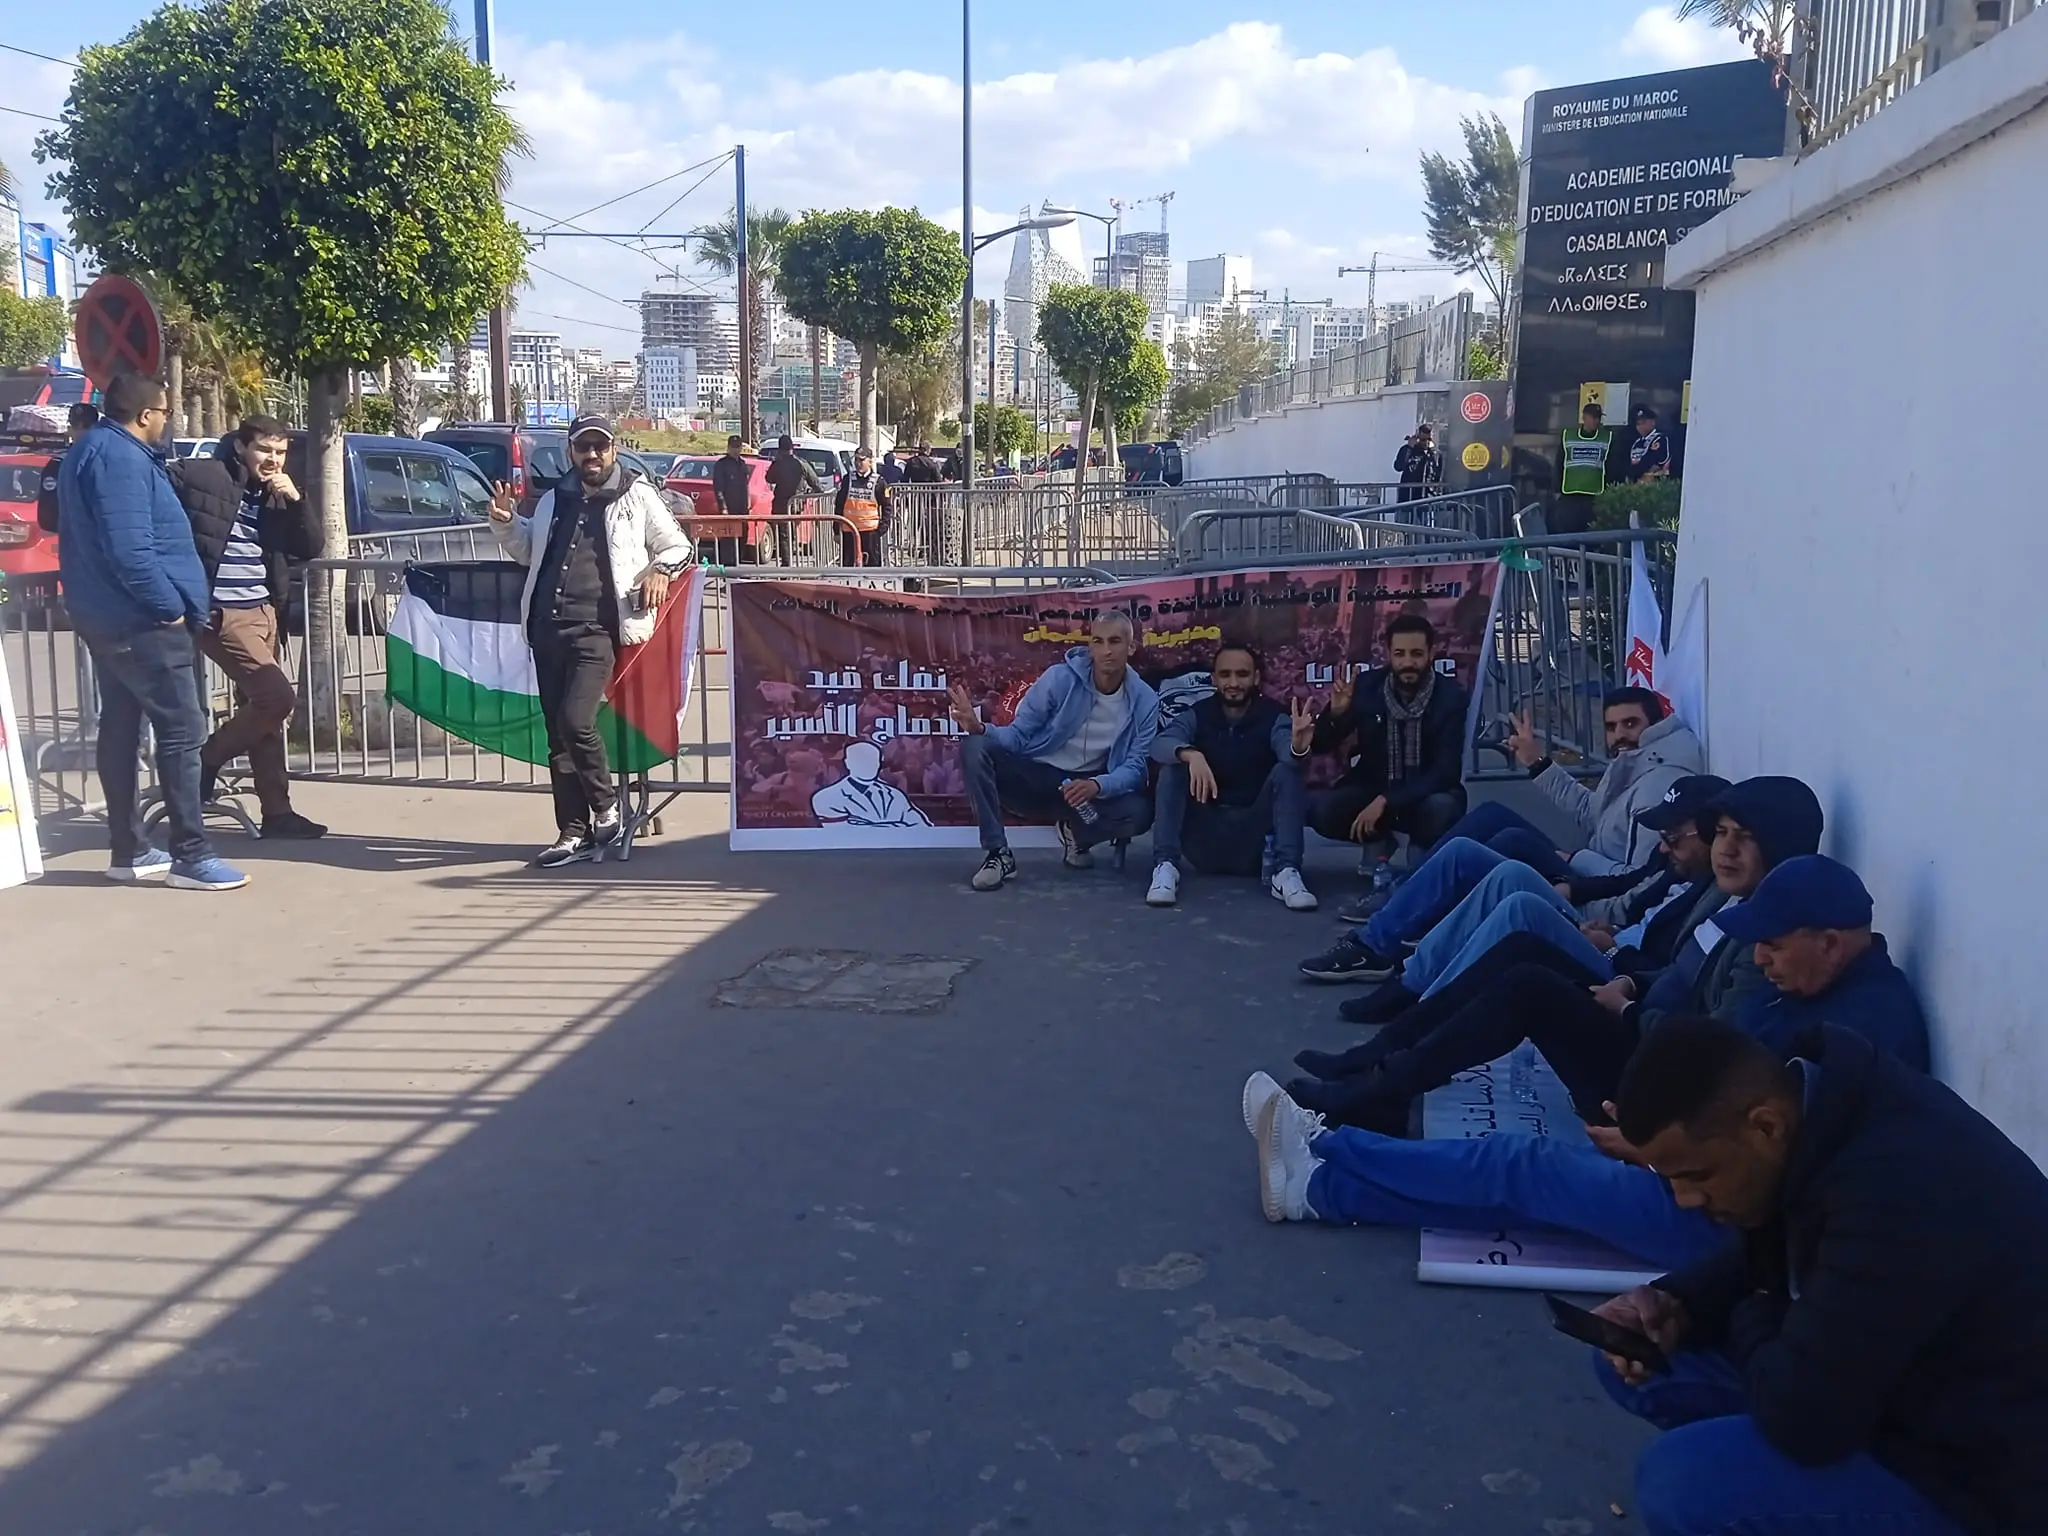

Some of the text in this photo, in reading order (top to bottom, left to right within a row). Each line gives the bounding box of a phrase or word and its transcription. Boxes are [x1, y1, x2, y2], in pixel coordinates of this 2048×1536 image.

[1553, 89, 1680, 117] ROYAUME DU MAROC
[1583, 117, 1593, 129] DE
[1594, 111, 1642, 128] L'EDUCATION
[1644, 105, 1688, 121] NATIONALE
[1567, 164, 1645, 191] ACADEMIE
[1531, 198, 1630, 224] D'EDUCATION
[1634, 196, 1654, 215] ET
[1659, 192, 1680, 211] DE
[1566, 228, 1668, 254] CASABLANCA
[806, 658, 948, 694] نفك قيد
[762, 701, 859, 741] الأسير
